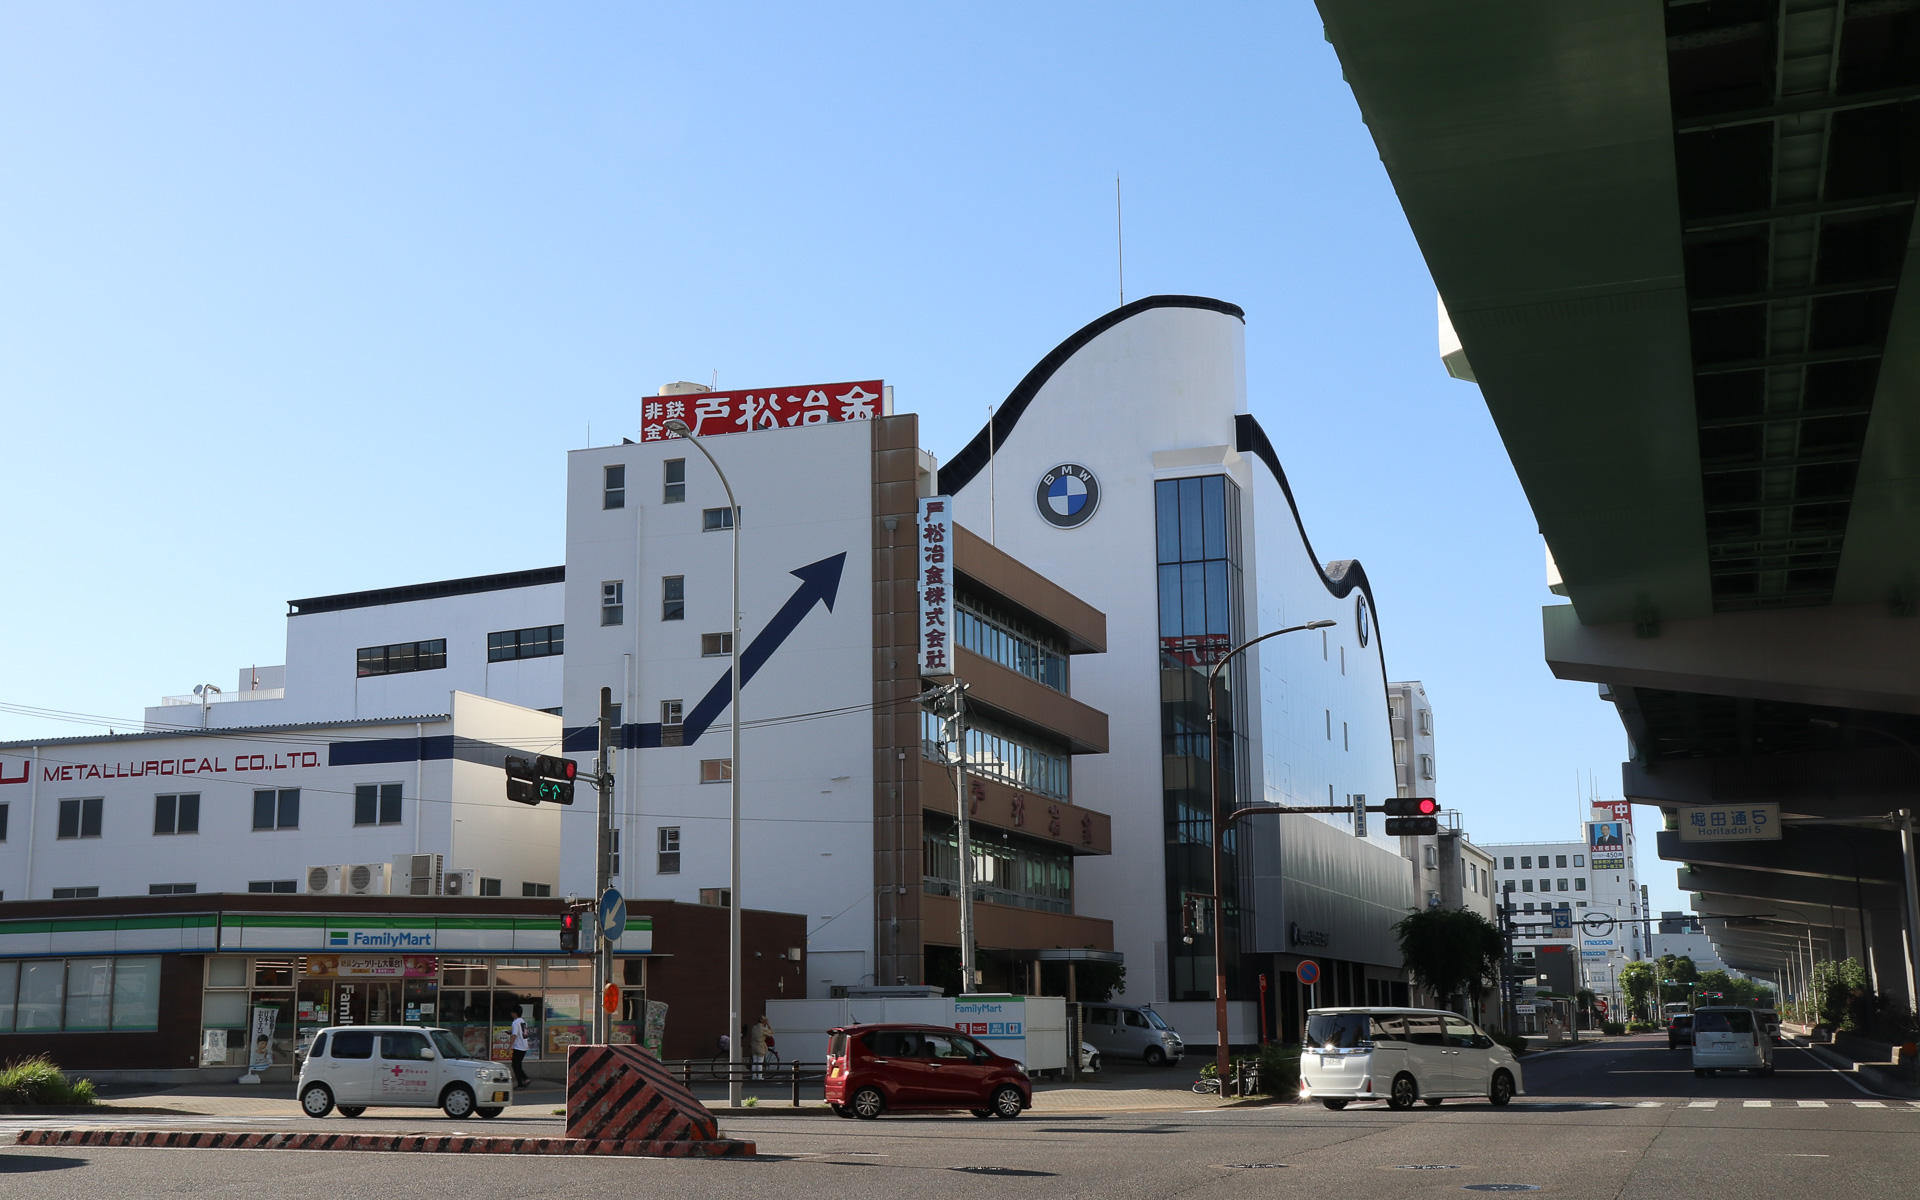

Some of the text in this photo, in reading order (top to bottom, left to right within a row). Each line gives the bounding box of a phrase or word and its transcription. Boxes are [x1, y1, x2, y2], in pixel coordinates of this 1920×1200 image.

[644, 400, 685, 420] 非鉄
[1043, 465, 1092, 486] BMW
[922, 501, 946, 669] 戸松冶金株式会社
[43, 755, 227, 782] METALLURGICAL
[234, 750, 321, 773] CO.,LTD.
[1691, 810, 1767, 827] 堀田通5
[1698, 826, 1761, 835] Horitadori 5
[353, 931, 432, 948] FamilyMart
[954, 1003, 1002, 1015] FamilyMart
